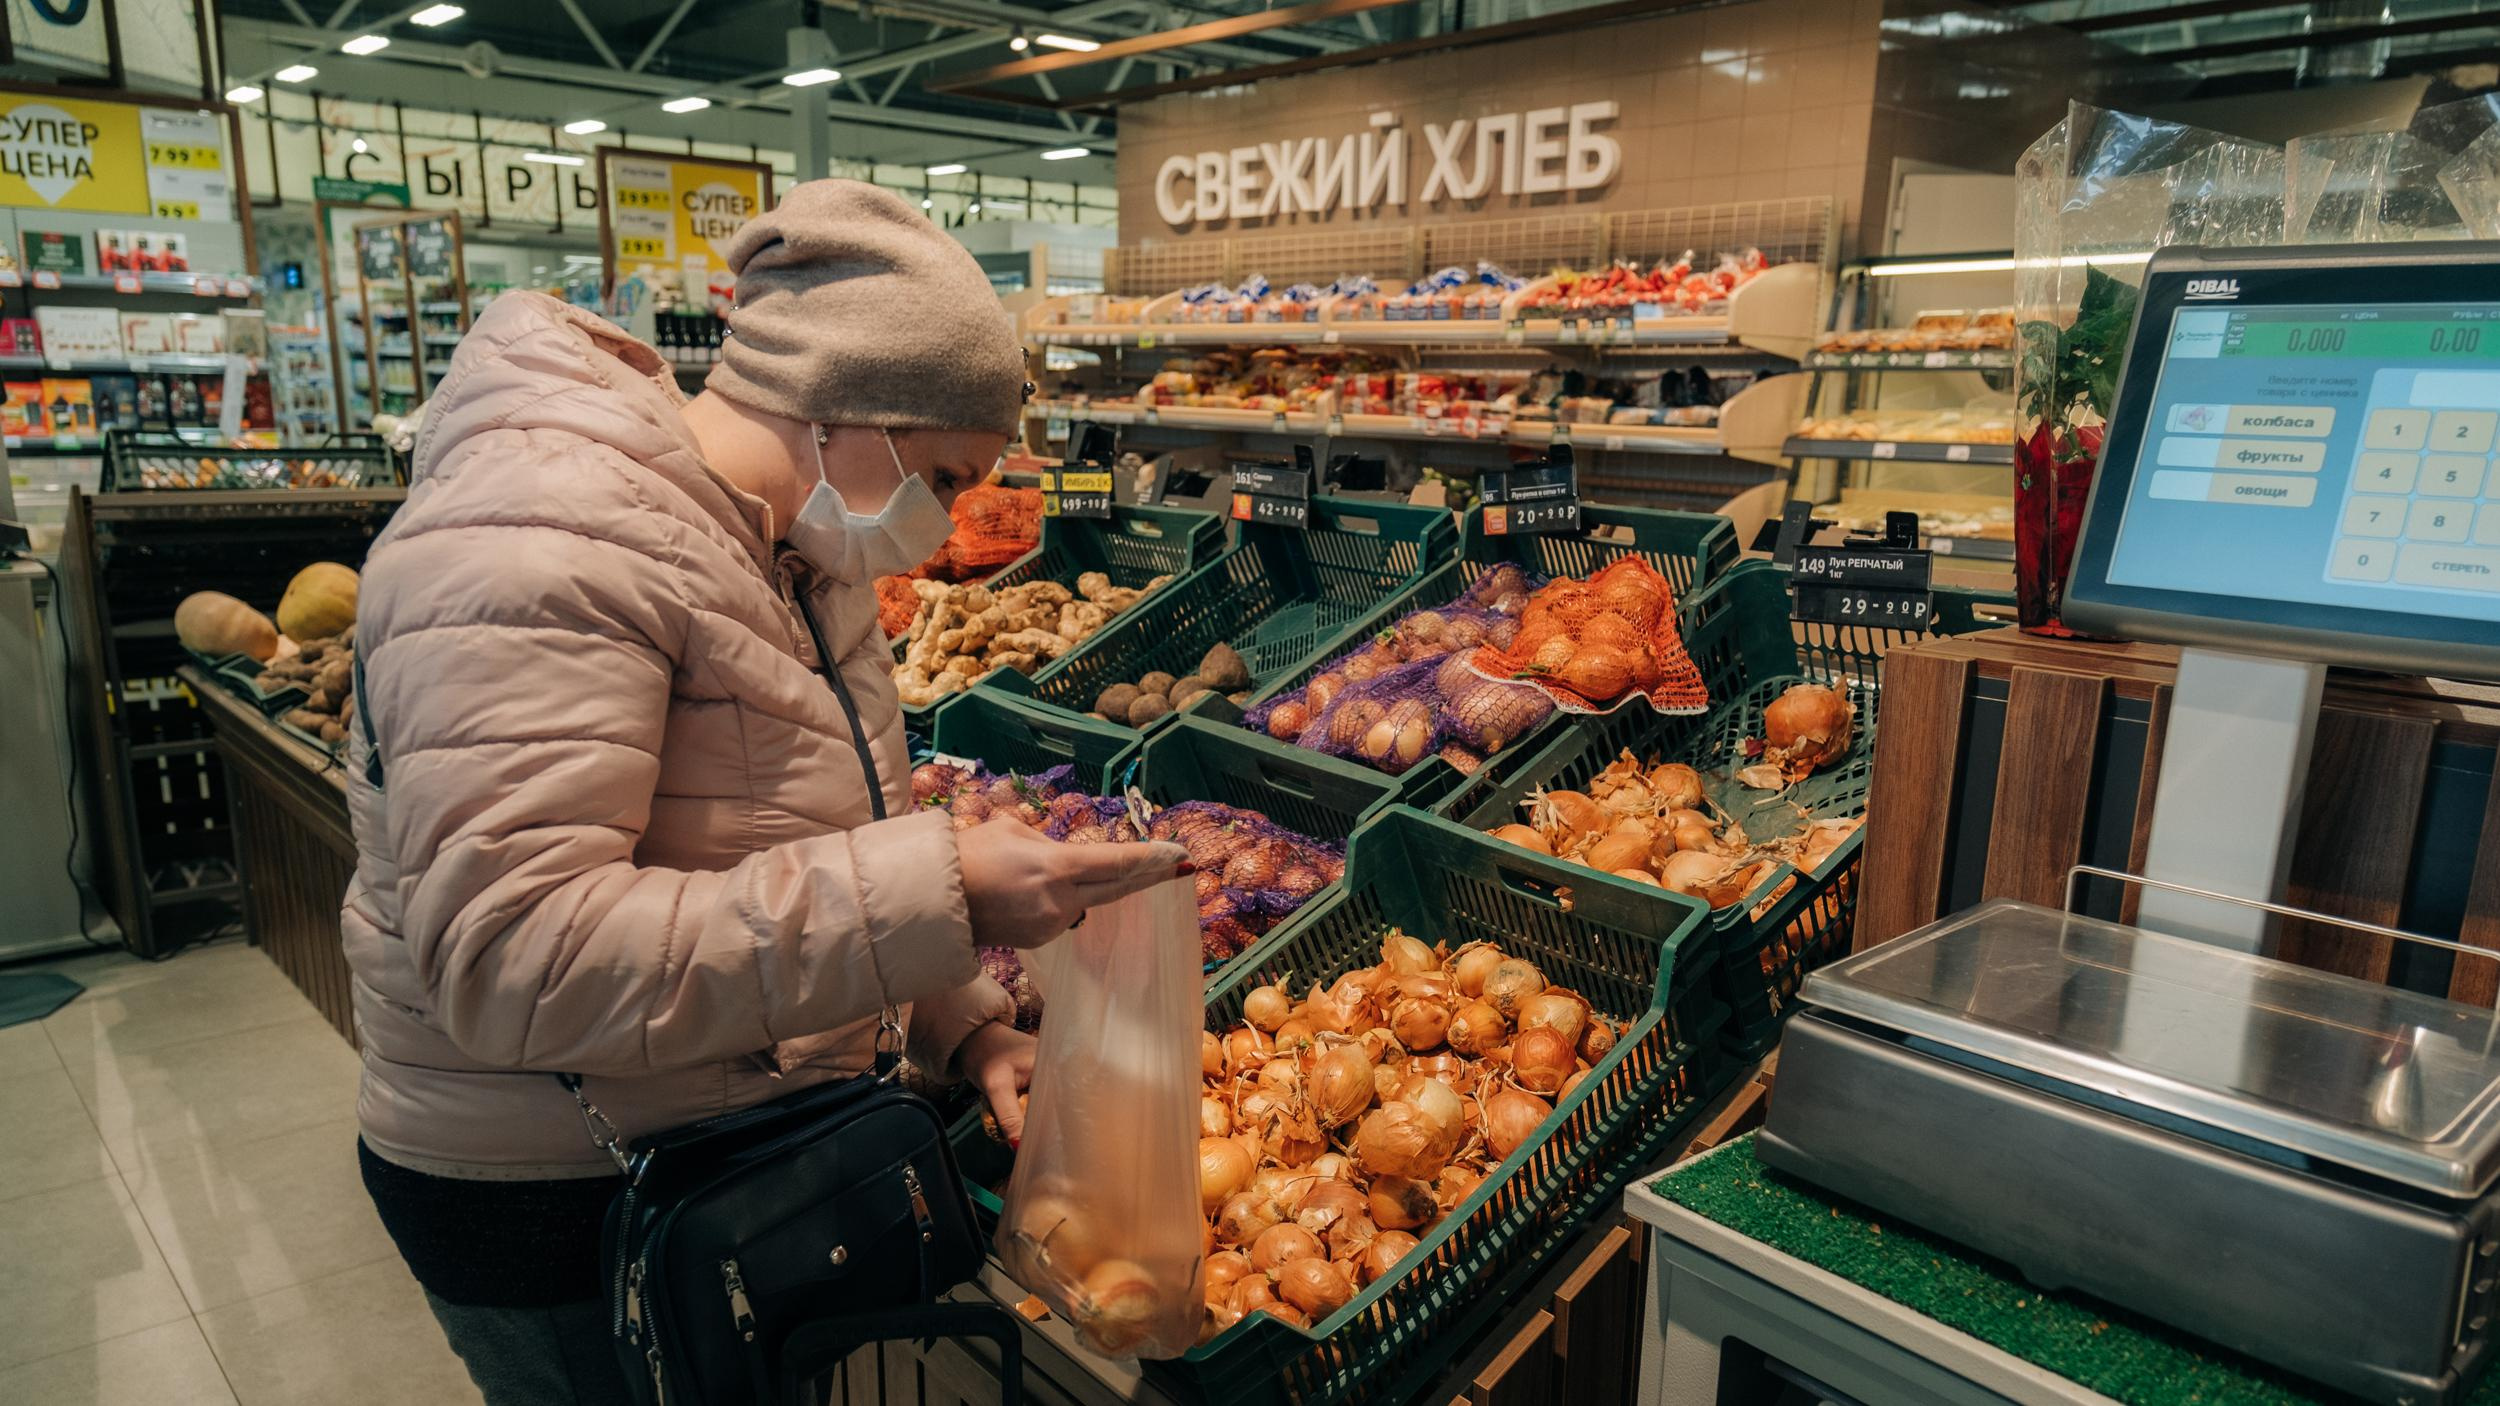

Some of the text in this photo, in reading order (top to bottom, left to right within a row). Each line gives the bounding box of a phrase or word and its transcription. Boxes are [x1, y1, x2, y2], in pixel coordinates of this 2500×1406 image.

[1, 150, 94, 182] ЦЕНА
[1156, 101, 1621, 225] СВЕЖИЙ ХЛЕБ
[682, 190, 754, 215] СУПЕР
[2185, 279, 2240, 293] DIBAL
[2242, 416, 2315, 428] колбаса
[2394, 424, 2402, 436] 1
[2456, 426, 2469, 438] 2
[2237, 450, 2303, 464] фрукты
[2379, 468, 2392, 479] 4
[2445, 471, 2457, 482] 5
[2234, 485, 2288, 497] овощи
[2369, 511, 2380, 523] 7
[2433, 515, 2445, 527] 8
[1800, 558, 1826, 574] 149
[1829, 557, 1904, 570] Лук РЕПЧАТЫЙ
[2357, 555, 2369, 566] 0
[2431, 561, 2490, 574] СТЕРЕТЬ
